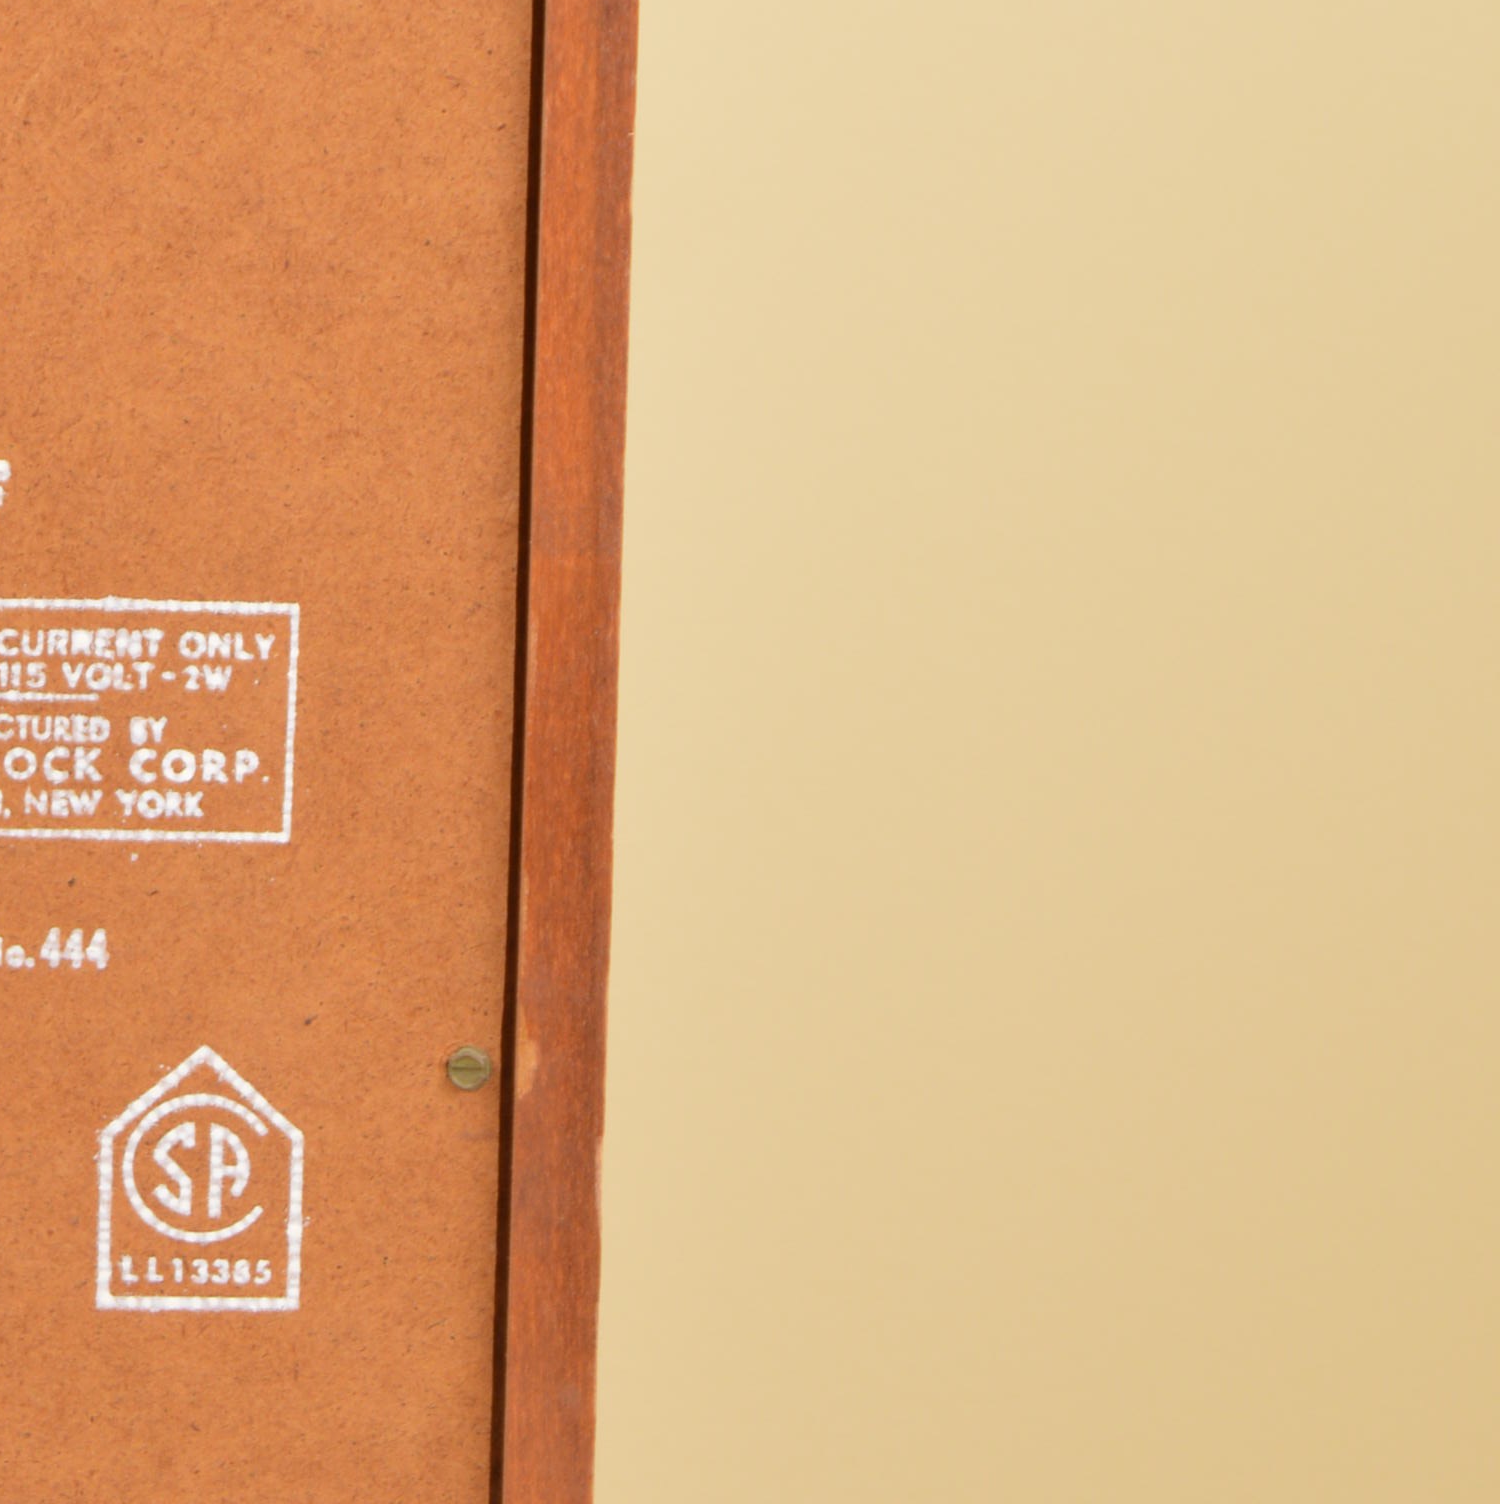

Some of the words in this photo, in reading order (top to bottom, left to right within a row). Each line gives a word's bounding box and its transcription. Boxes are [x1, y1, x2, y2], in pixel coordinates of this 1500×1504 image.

[178, 630, 277, 661] ONLY
[129, 716, 169, 746] BY
[128, 748, 271, 786] CORP.
[24, 787, 104, 818] NEW
[115, 789, 205, 820] YORK
